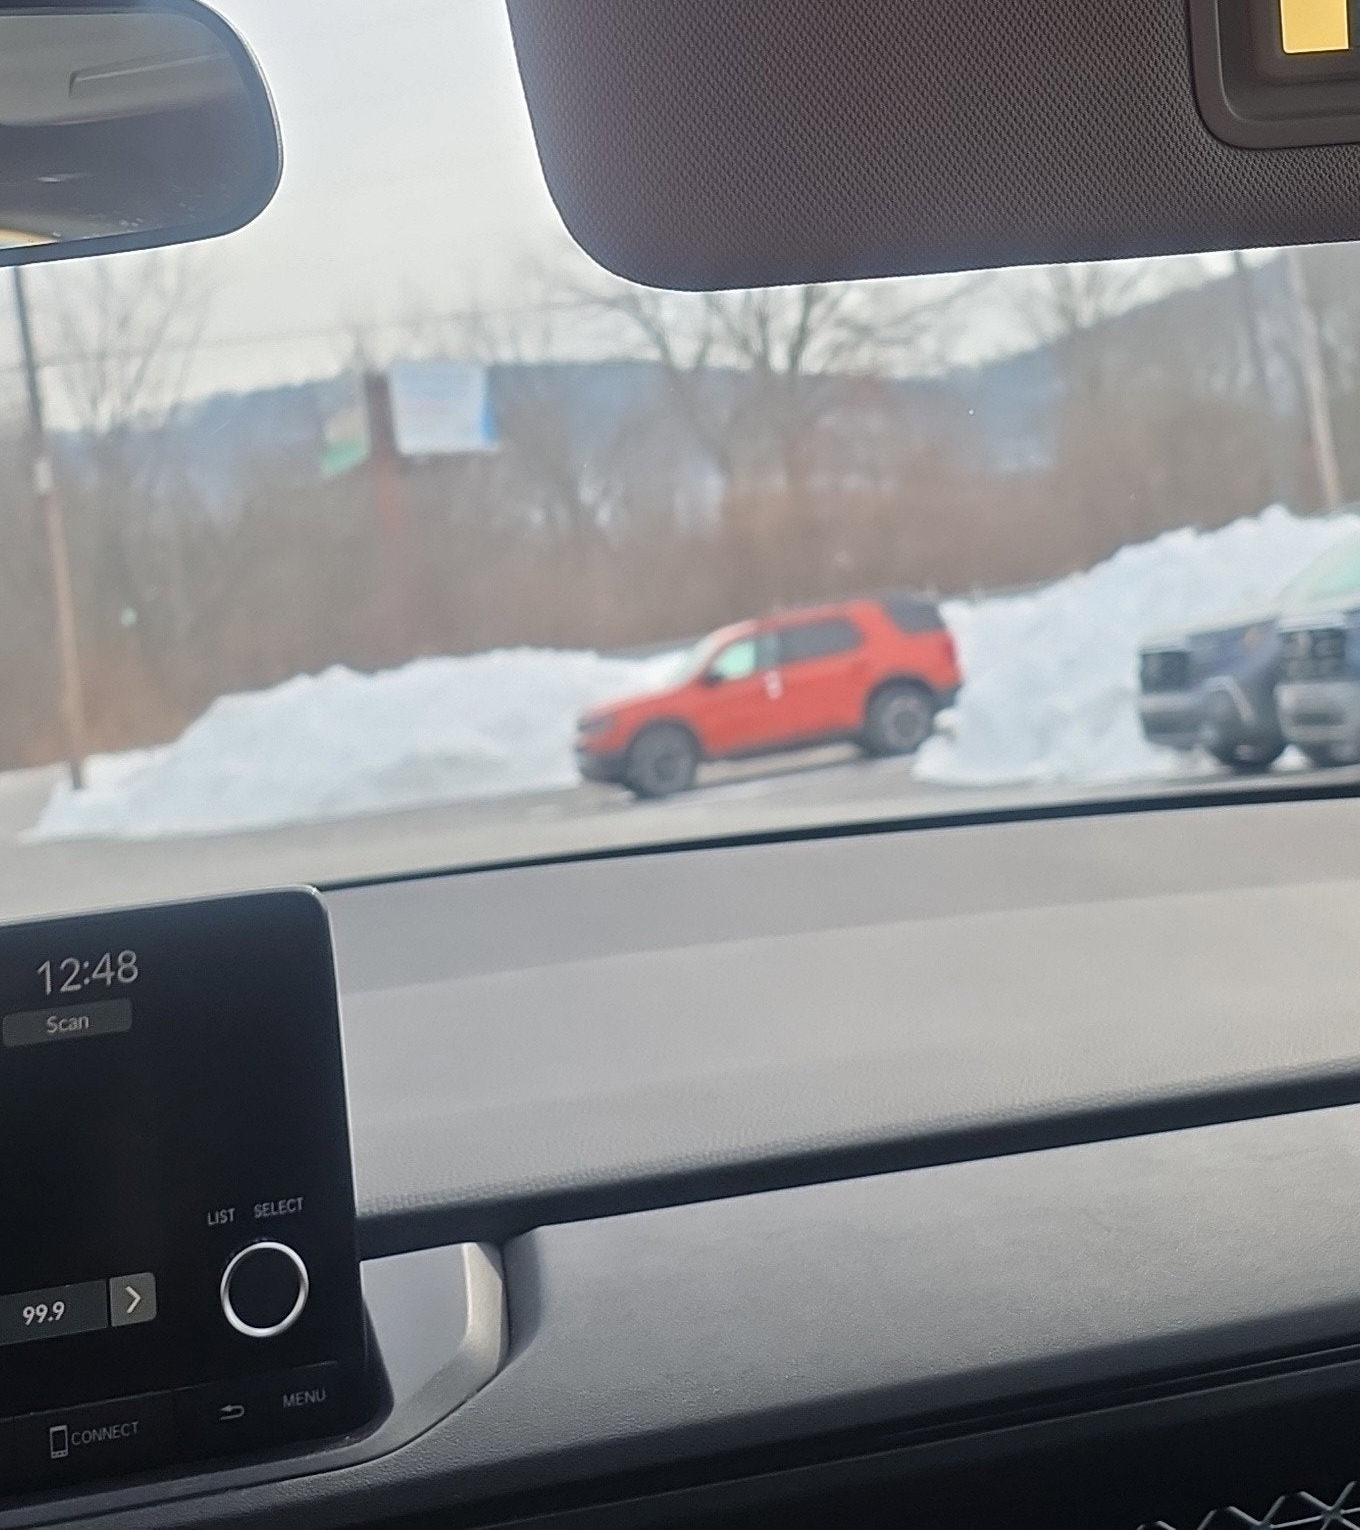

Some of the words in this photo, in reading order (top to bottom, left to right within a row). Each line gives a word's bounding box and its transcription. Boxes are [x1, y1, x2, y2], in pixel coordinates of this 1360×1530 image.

[37, 950, 139, 995] 12:48
[46, 1014, 90, 1034] Scan
[207, 1207, 236, 1226] LIST
[254, 1196, 304, 1219] SELECT
[22, 1301, 66, 1326] 99.9
[282, 1388, 327, 1408] MENU
[71, 1421, 139, 1447] CONNECT
